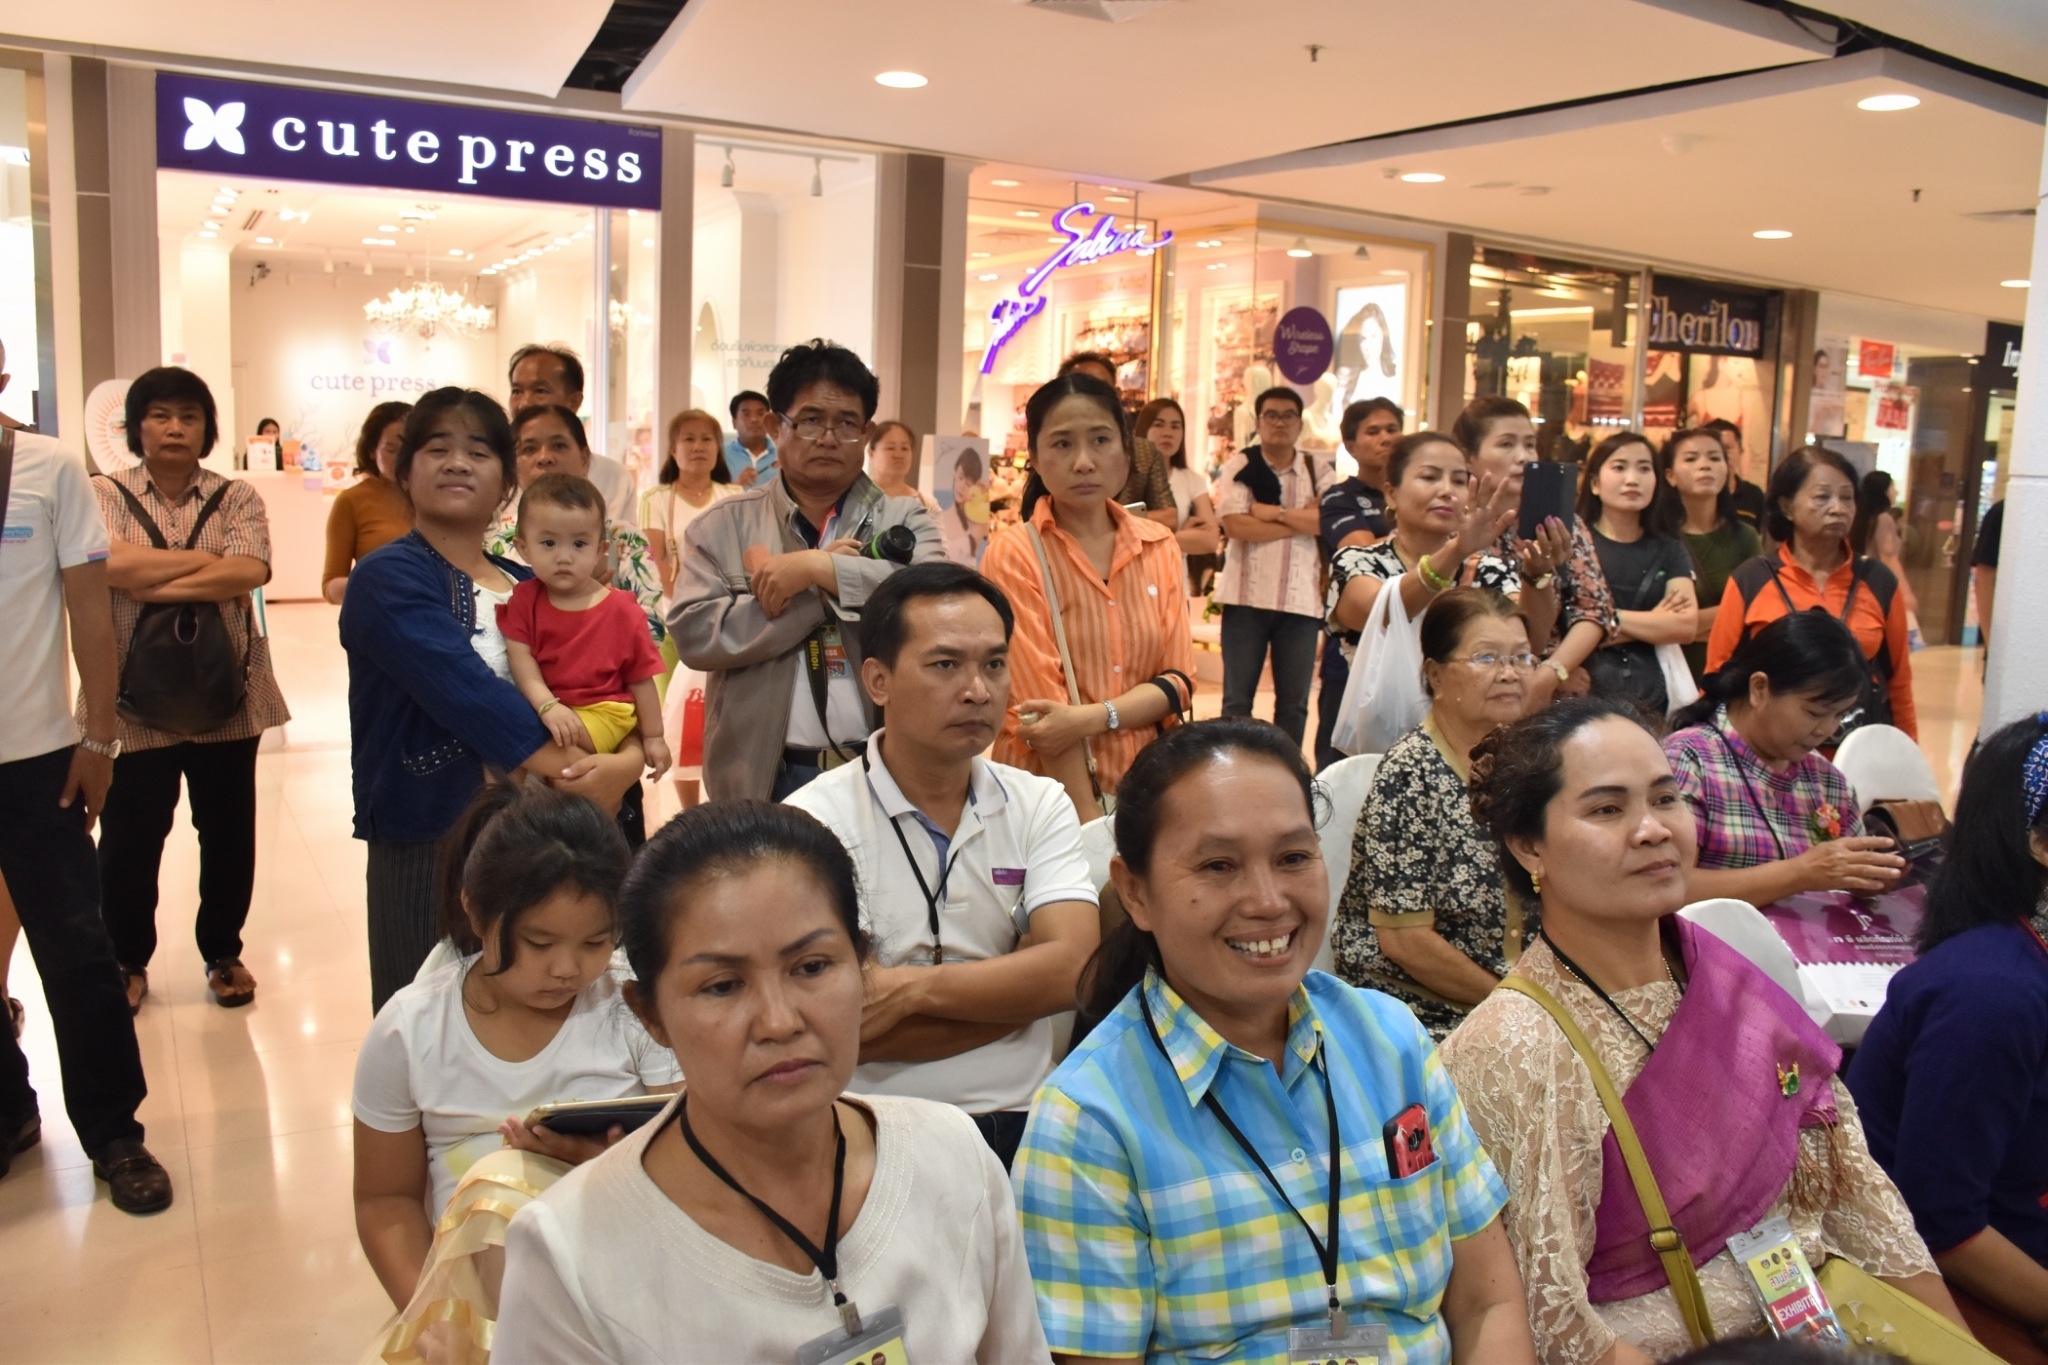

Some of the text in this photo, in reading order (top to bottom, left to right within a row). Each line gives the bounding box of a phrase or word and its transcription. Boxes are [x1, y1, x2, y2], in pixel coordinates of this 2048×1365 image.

[271, 116, 643, 184] cute press
[311, 373, 437, 398] cute press
[824, 648, 839, 657] ESS
[1777, 1295, 1817, 1321] EXHIBIT
